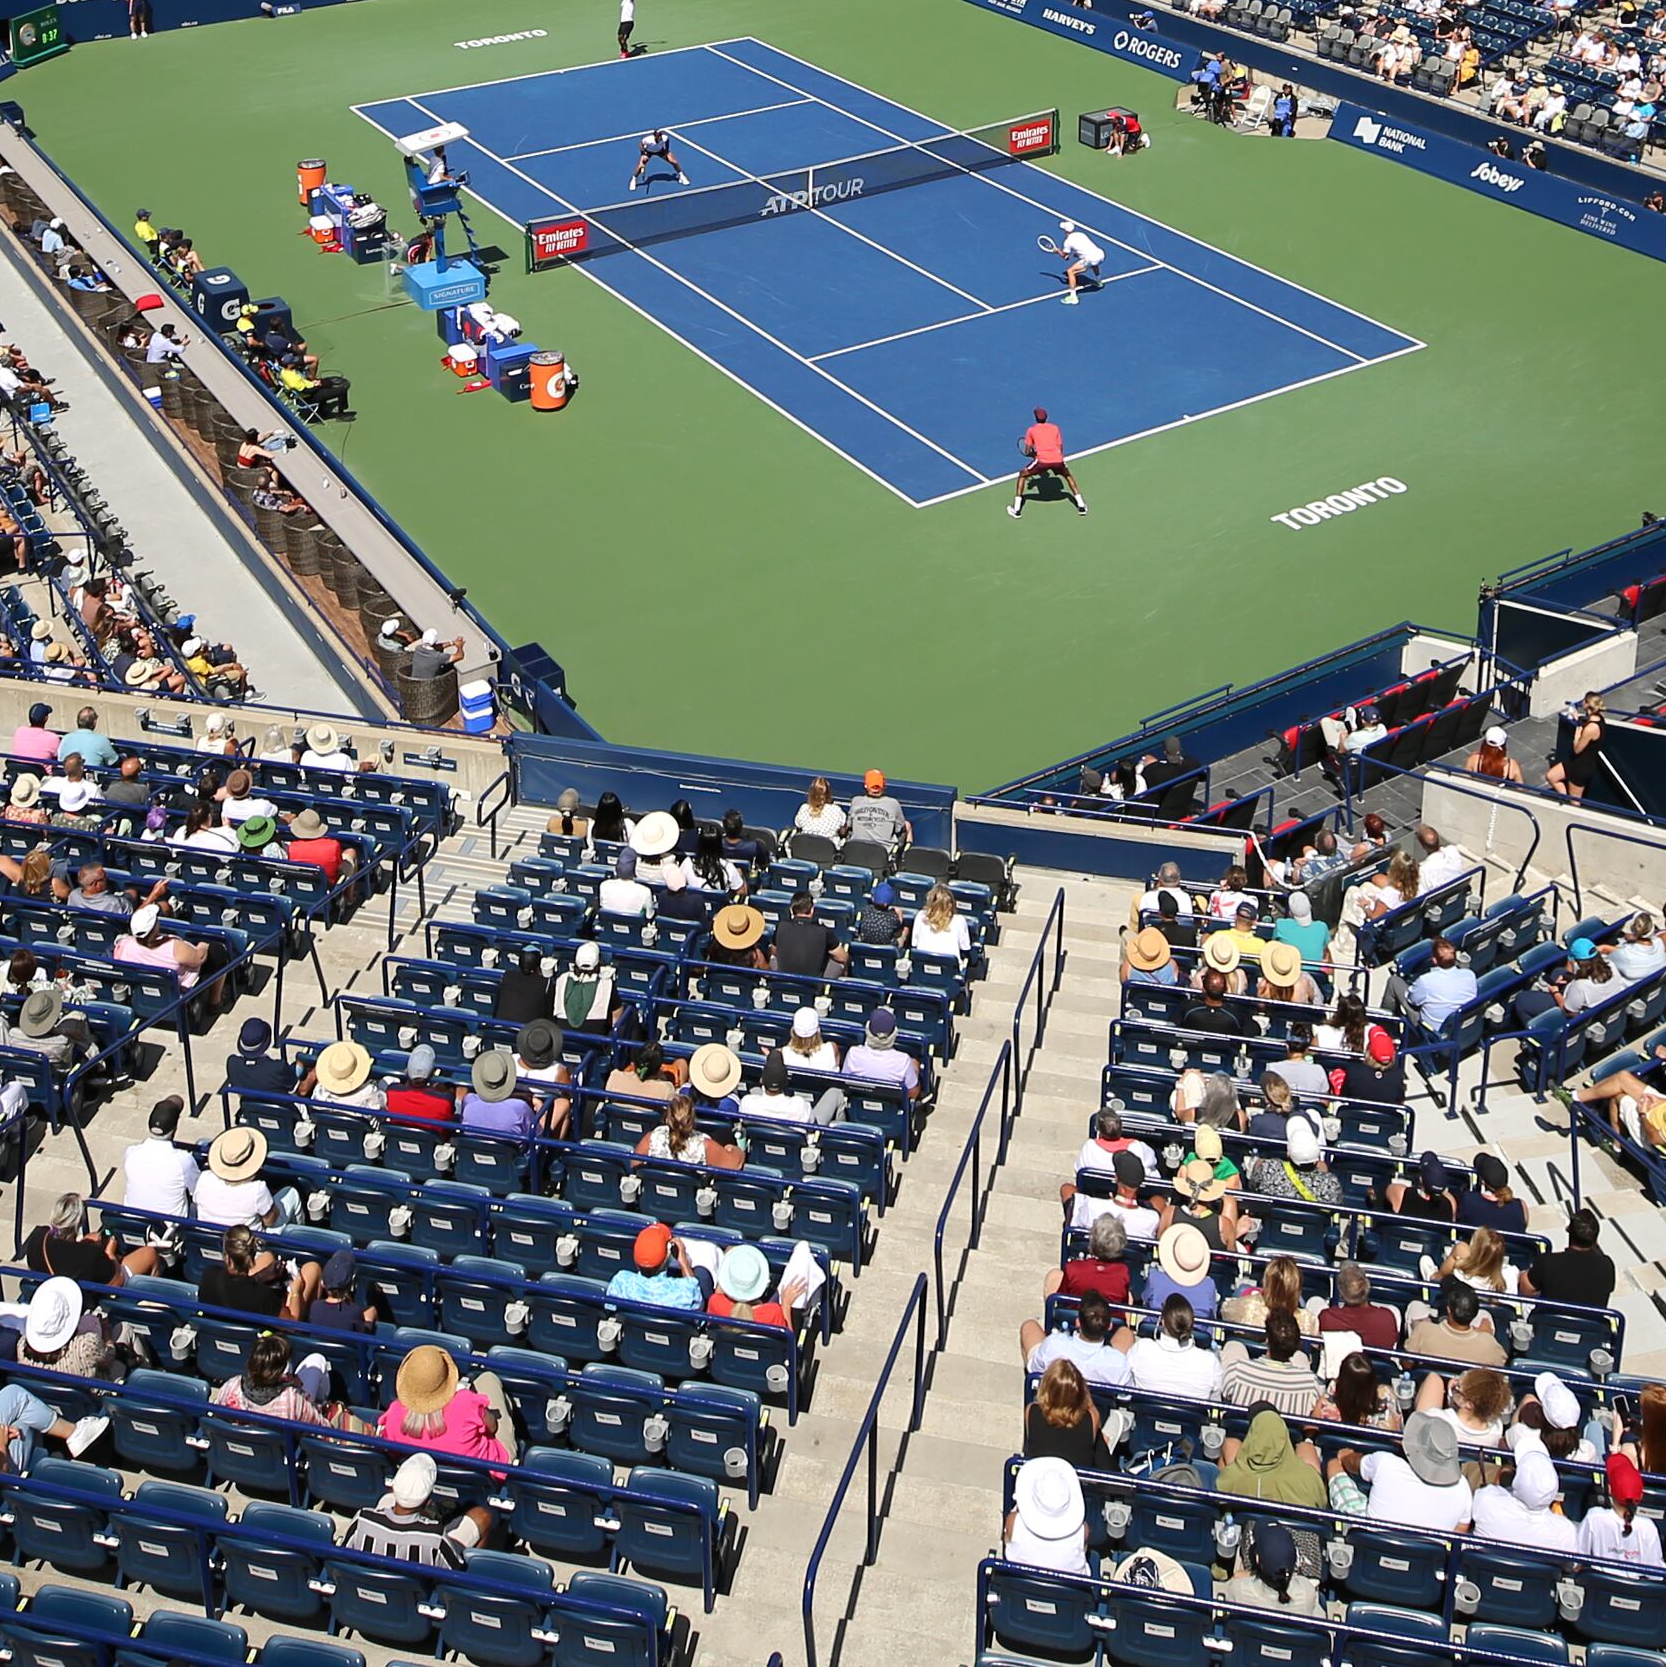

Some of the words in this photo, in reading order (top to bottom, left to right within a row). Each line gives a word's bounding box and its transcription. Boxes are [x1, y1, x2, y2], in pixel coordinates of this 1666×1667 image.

[277, 6, 295, 14] FILA
[1042, 8, 1097, 36] HARVEY'S
[453, 29, 549, 51] TORONTO
[1127, 39, 1182, 69] ROGERS
[1011, 124, 1050, 142] Emirates
[1383, 126, 1427, 150] NATIONAL
[1379, 136, 1405, 154] BANK
[1470, 162, 1524, 192] Sobeys
[758, 190, 808, 216] ATP
[813, 178, 864, 205] TOUR
[538, 227, 584, 245] Emirates
[545, 242, 556, 253] FLY
[556, 238, 577, 251] BETTER
[433, 285, 476, 300] SIGNATURE
[221, 298, 241, 321] G
[1270, 476, 1407, 530] TORONTO
